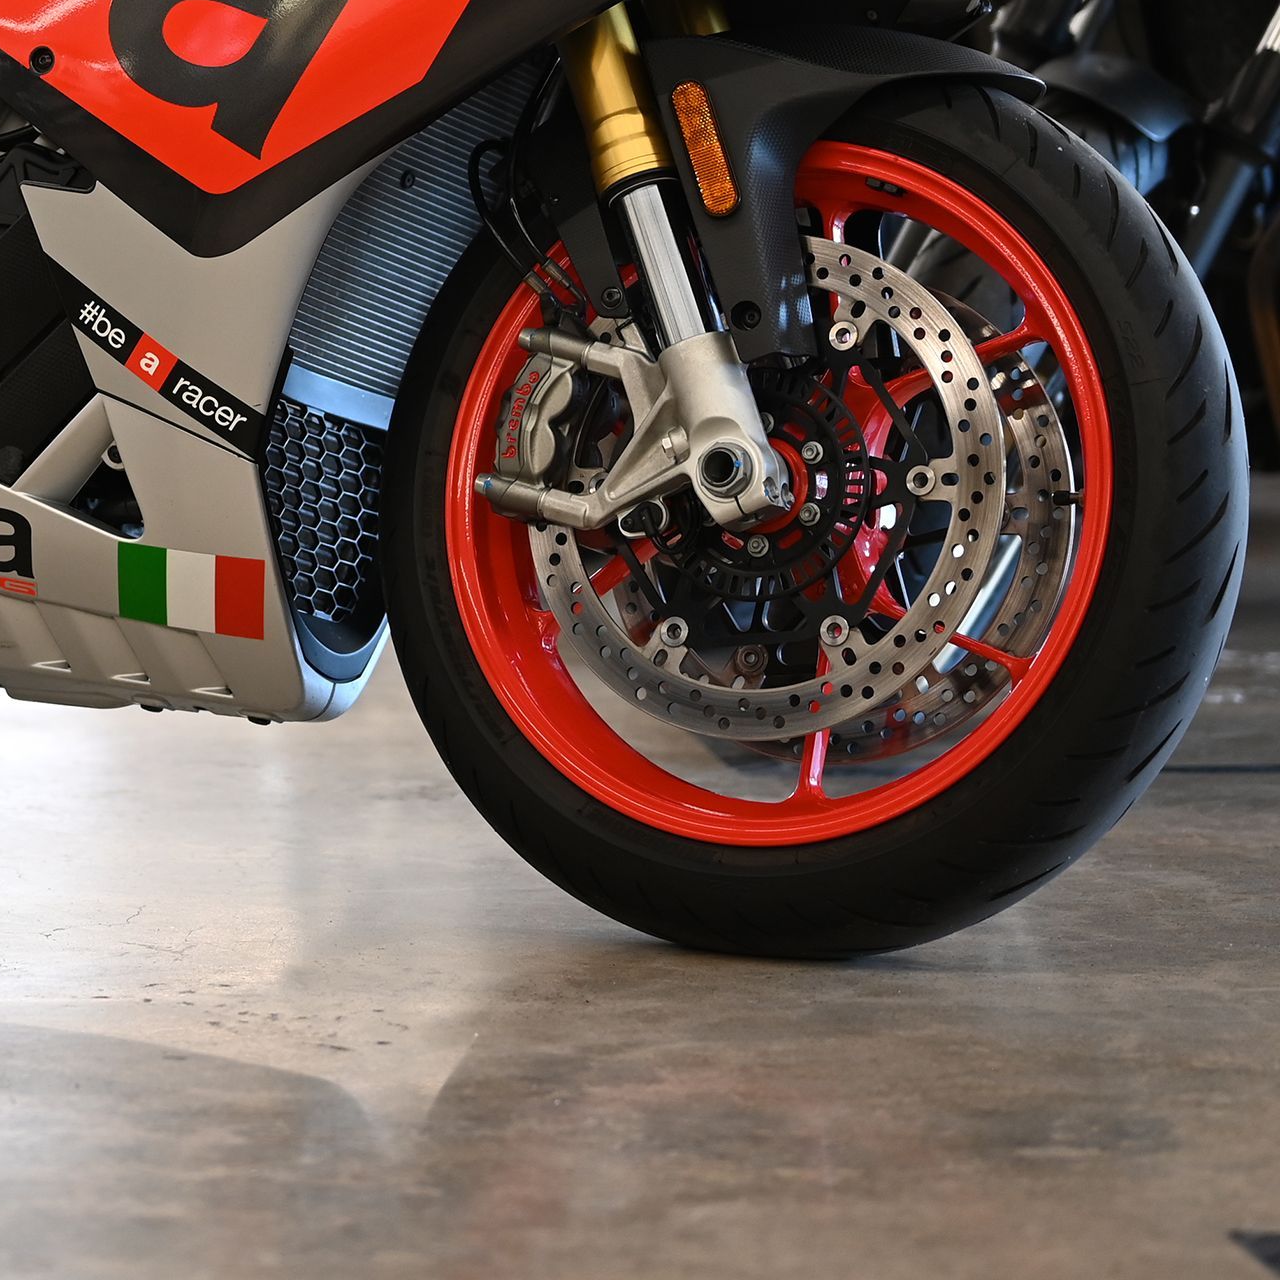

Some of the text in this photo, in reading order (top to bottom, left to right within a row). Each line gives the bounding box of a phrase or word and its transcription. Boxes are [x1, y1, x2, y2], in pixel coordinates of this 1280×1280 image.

[78, 300, 248, 432] #be a racer
[501, 371, 540, 459] brembo
